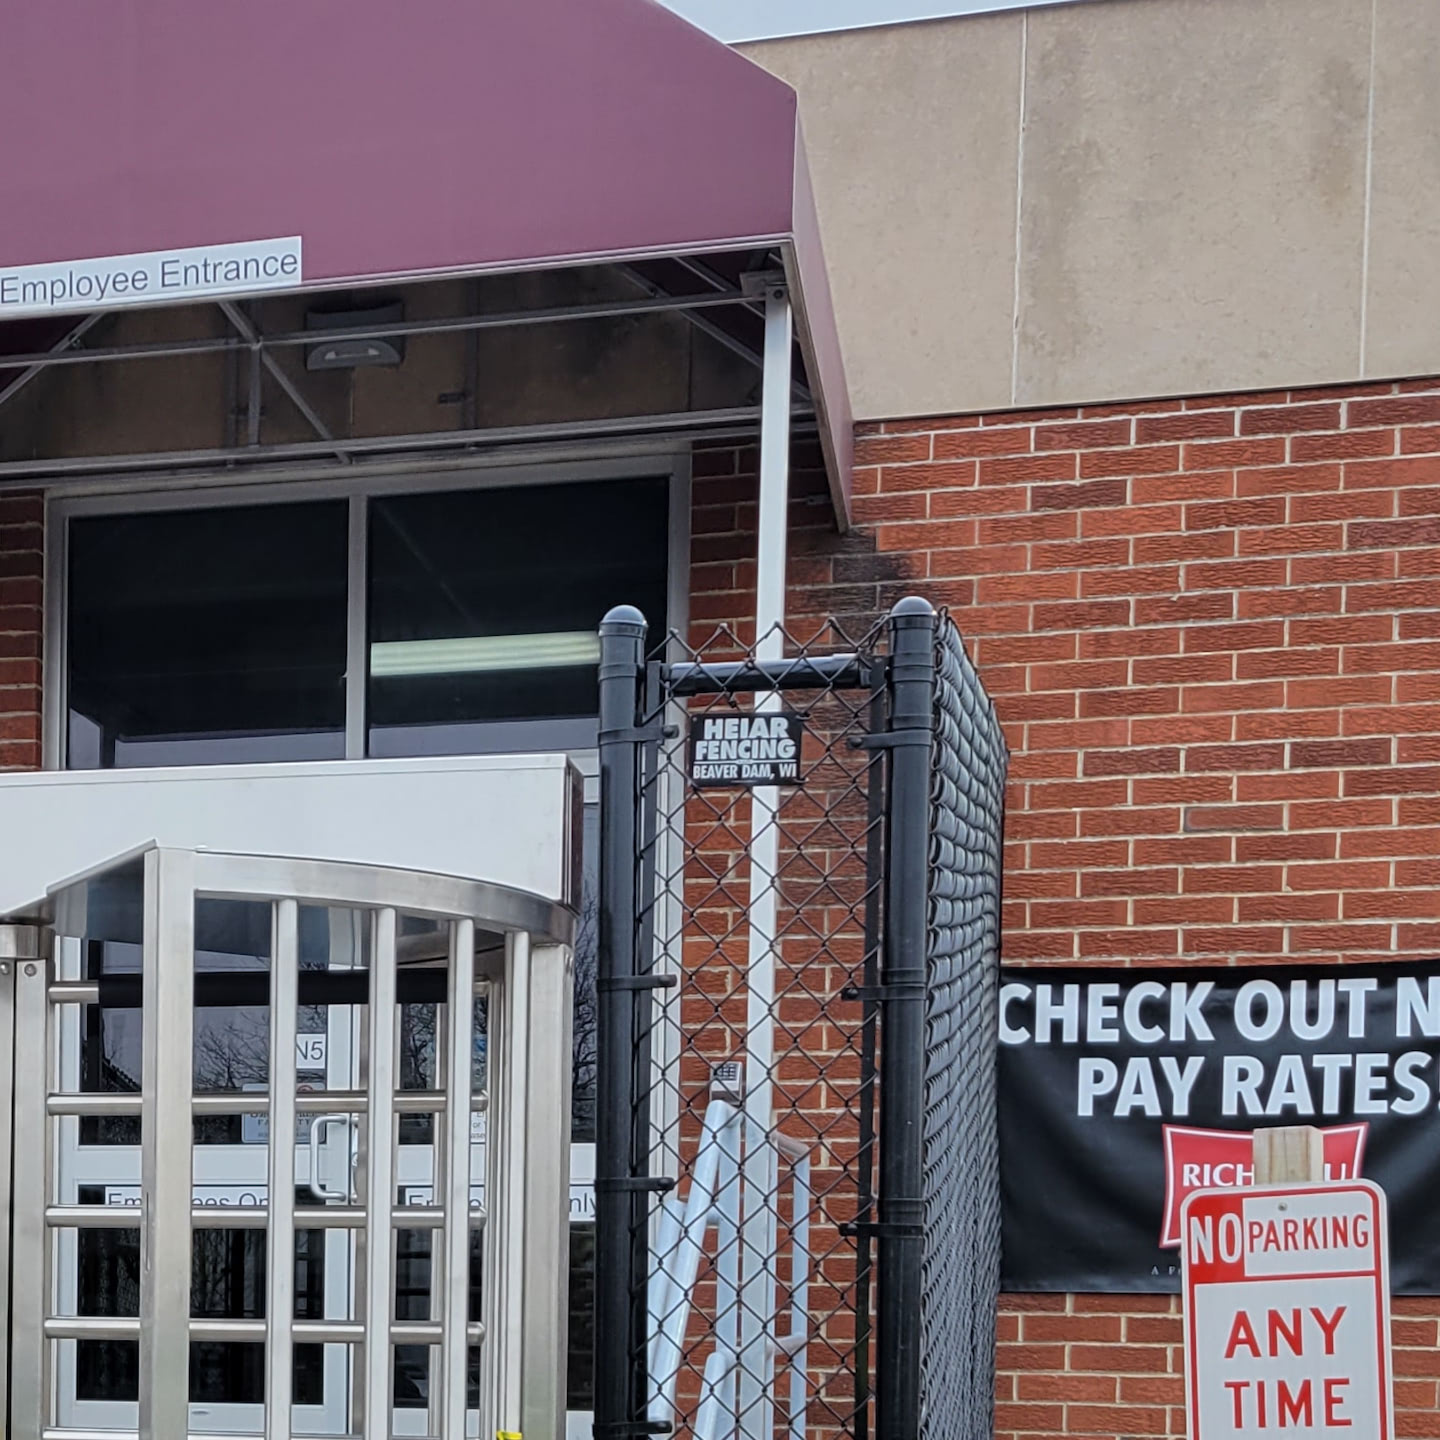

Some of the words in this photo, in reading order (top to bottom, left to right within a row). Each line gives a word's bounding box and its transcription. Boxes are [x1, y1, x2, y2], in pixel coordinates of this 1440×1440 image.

[0, 269, 149, 306] Employee
[161, 253, 298, 288] Entrance
[695, 739, 796, 760] FENCING
[703, 717, 789, 740] HEIAR
[692, 764, 738, 780] BEAVER
[741, 764, 775, 780] DAM,
[779, 763, 797, 778] WI
[998, 981, 1216, 1045] CHECK
[1234, 979, 1378, 1042] OUT
[1077, 1056, 1205, 1117] PAY
[1221, 1051, 1440, 1116] RATES
[1190, 1213, 1243, 1265] NO
[1248, 1214, 1369, 1254] PARKING
[1224, 1306, 1347, 1359] ANY
[1224, 1378, 1352, 1429] TIME
